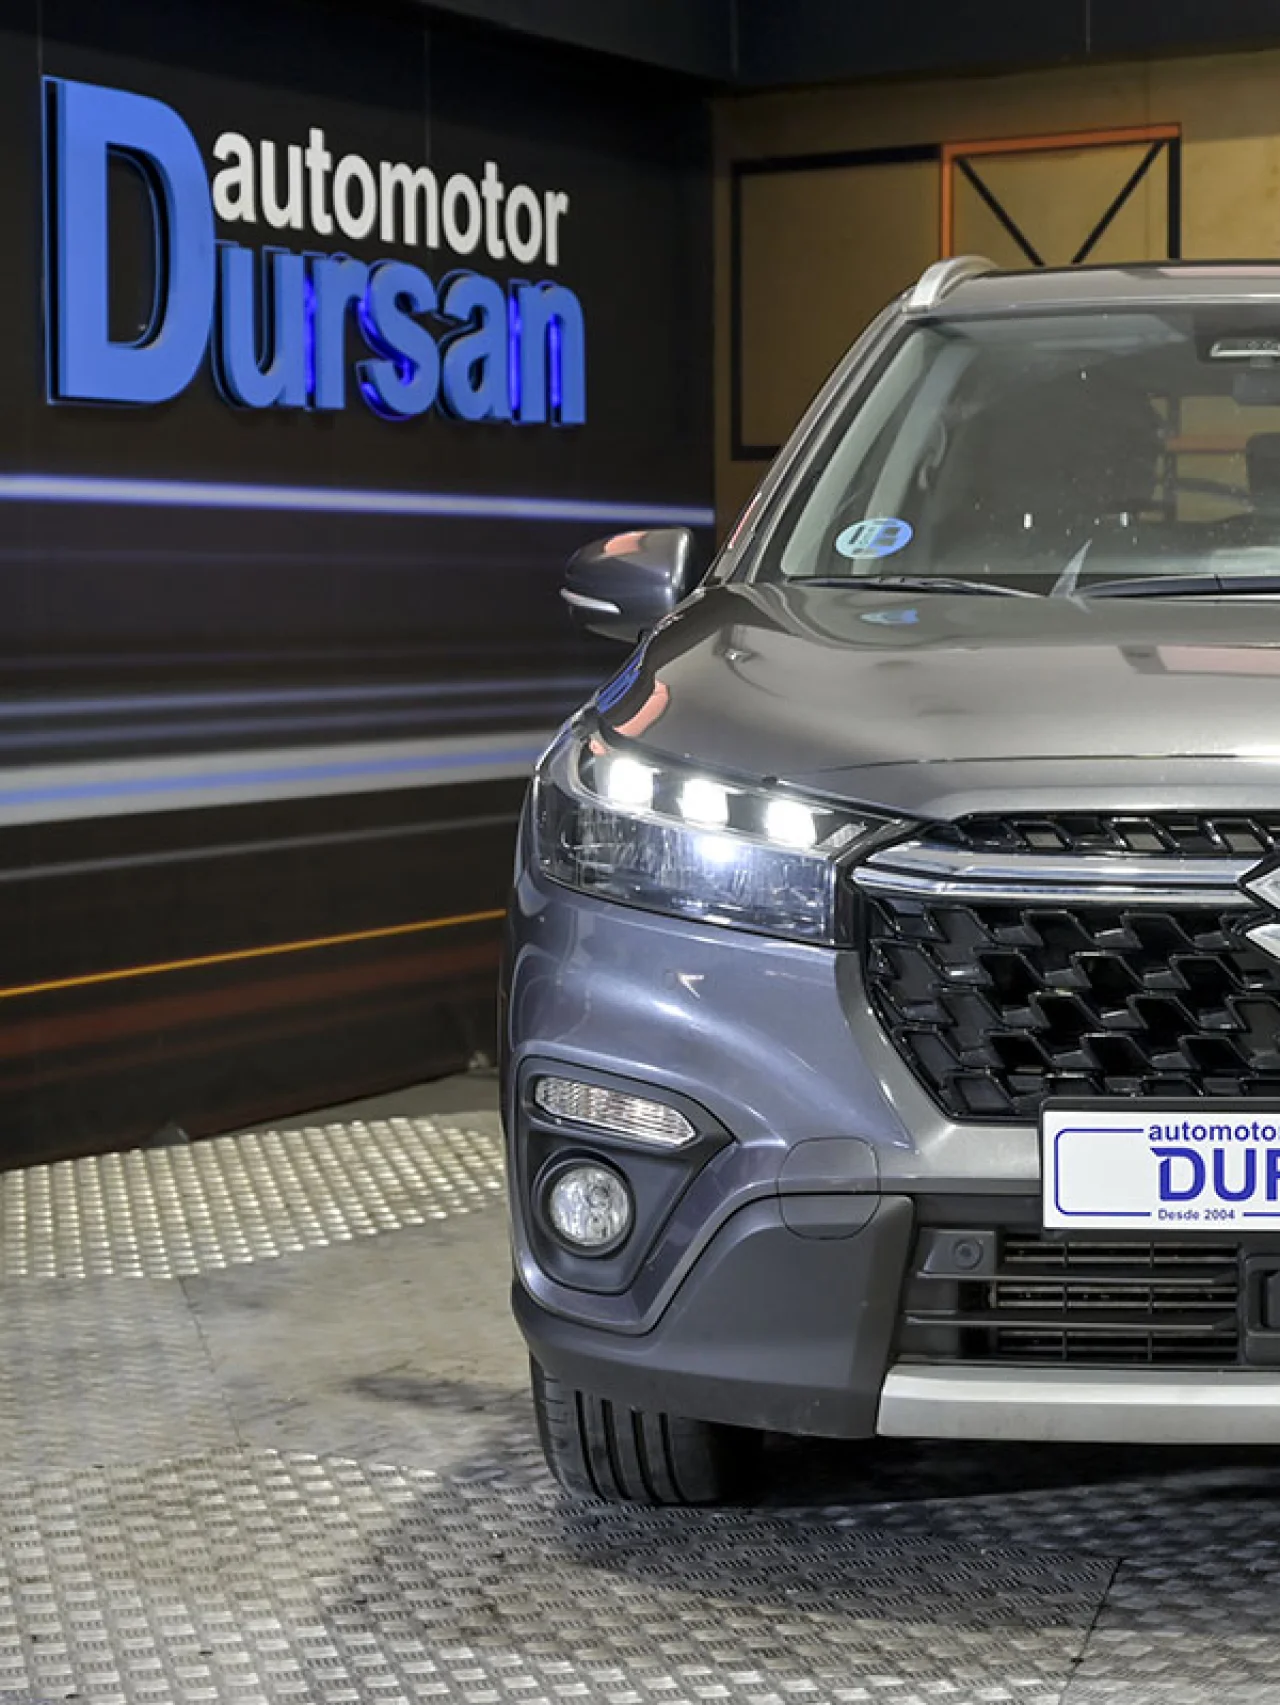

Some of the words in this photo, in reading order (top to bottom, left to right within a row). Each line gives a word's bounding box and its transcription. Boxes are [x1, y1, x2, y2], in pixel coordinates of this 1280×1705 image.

[42, 75, 587, 426] Dursan
[211, 127, 568, 266] automotor
[1158, 1208, 1200, 1221] Desde
[1204, 1208, 1236, 1221] 2004
